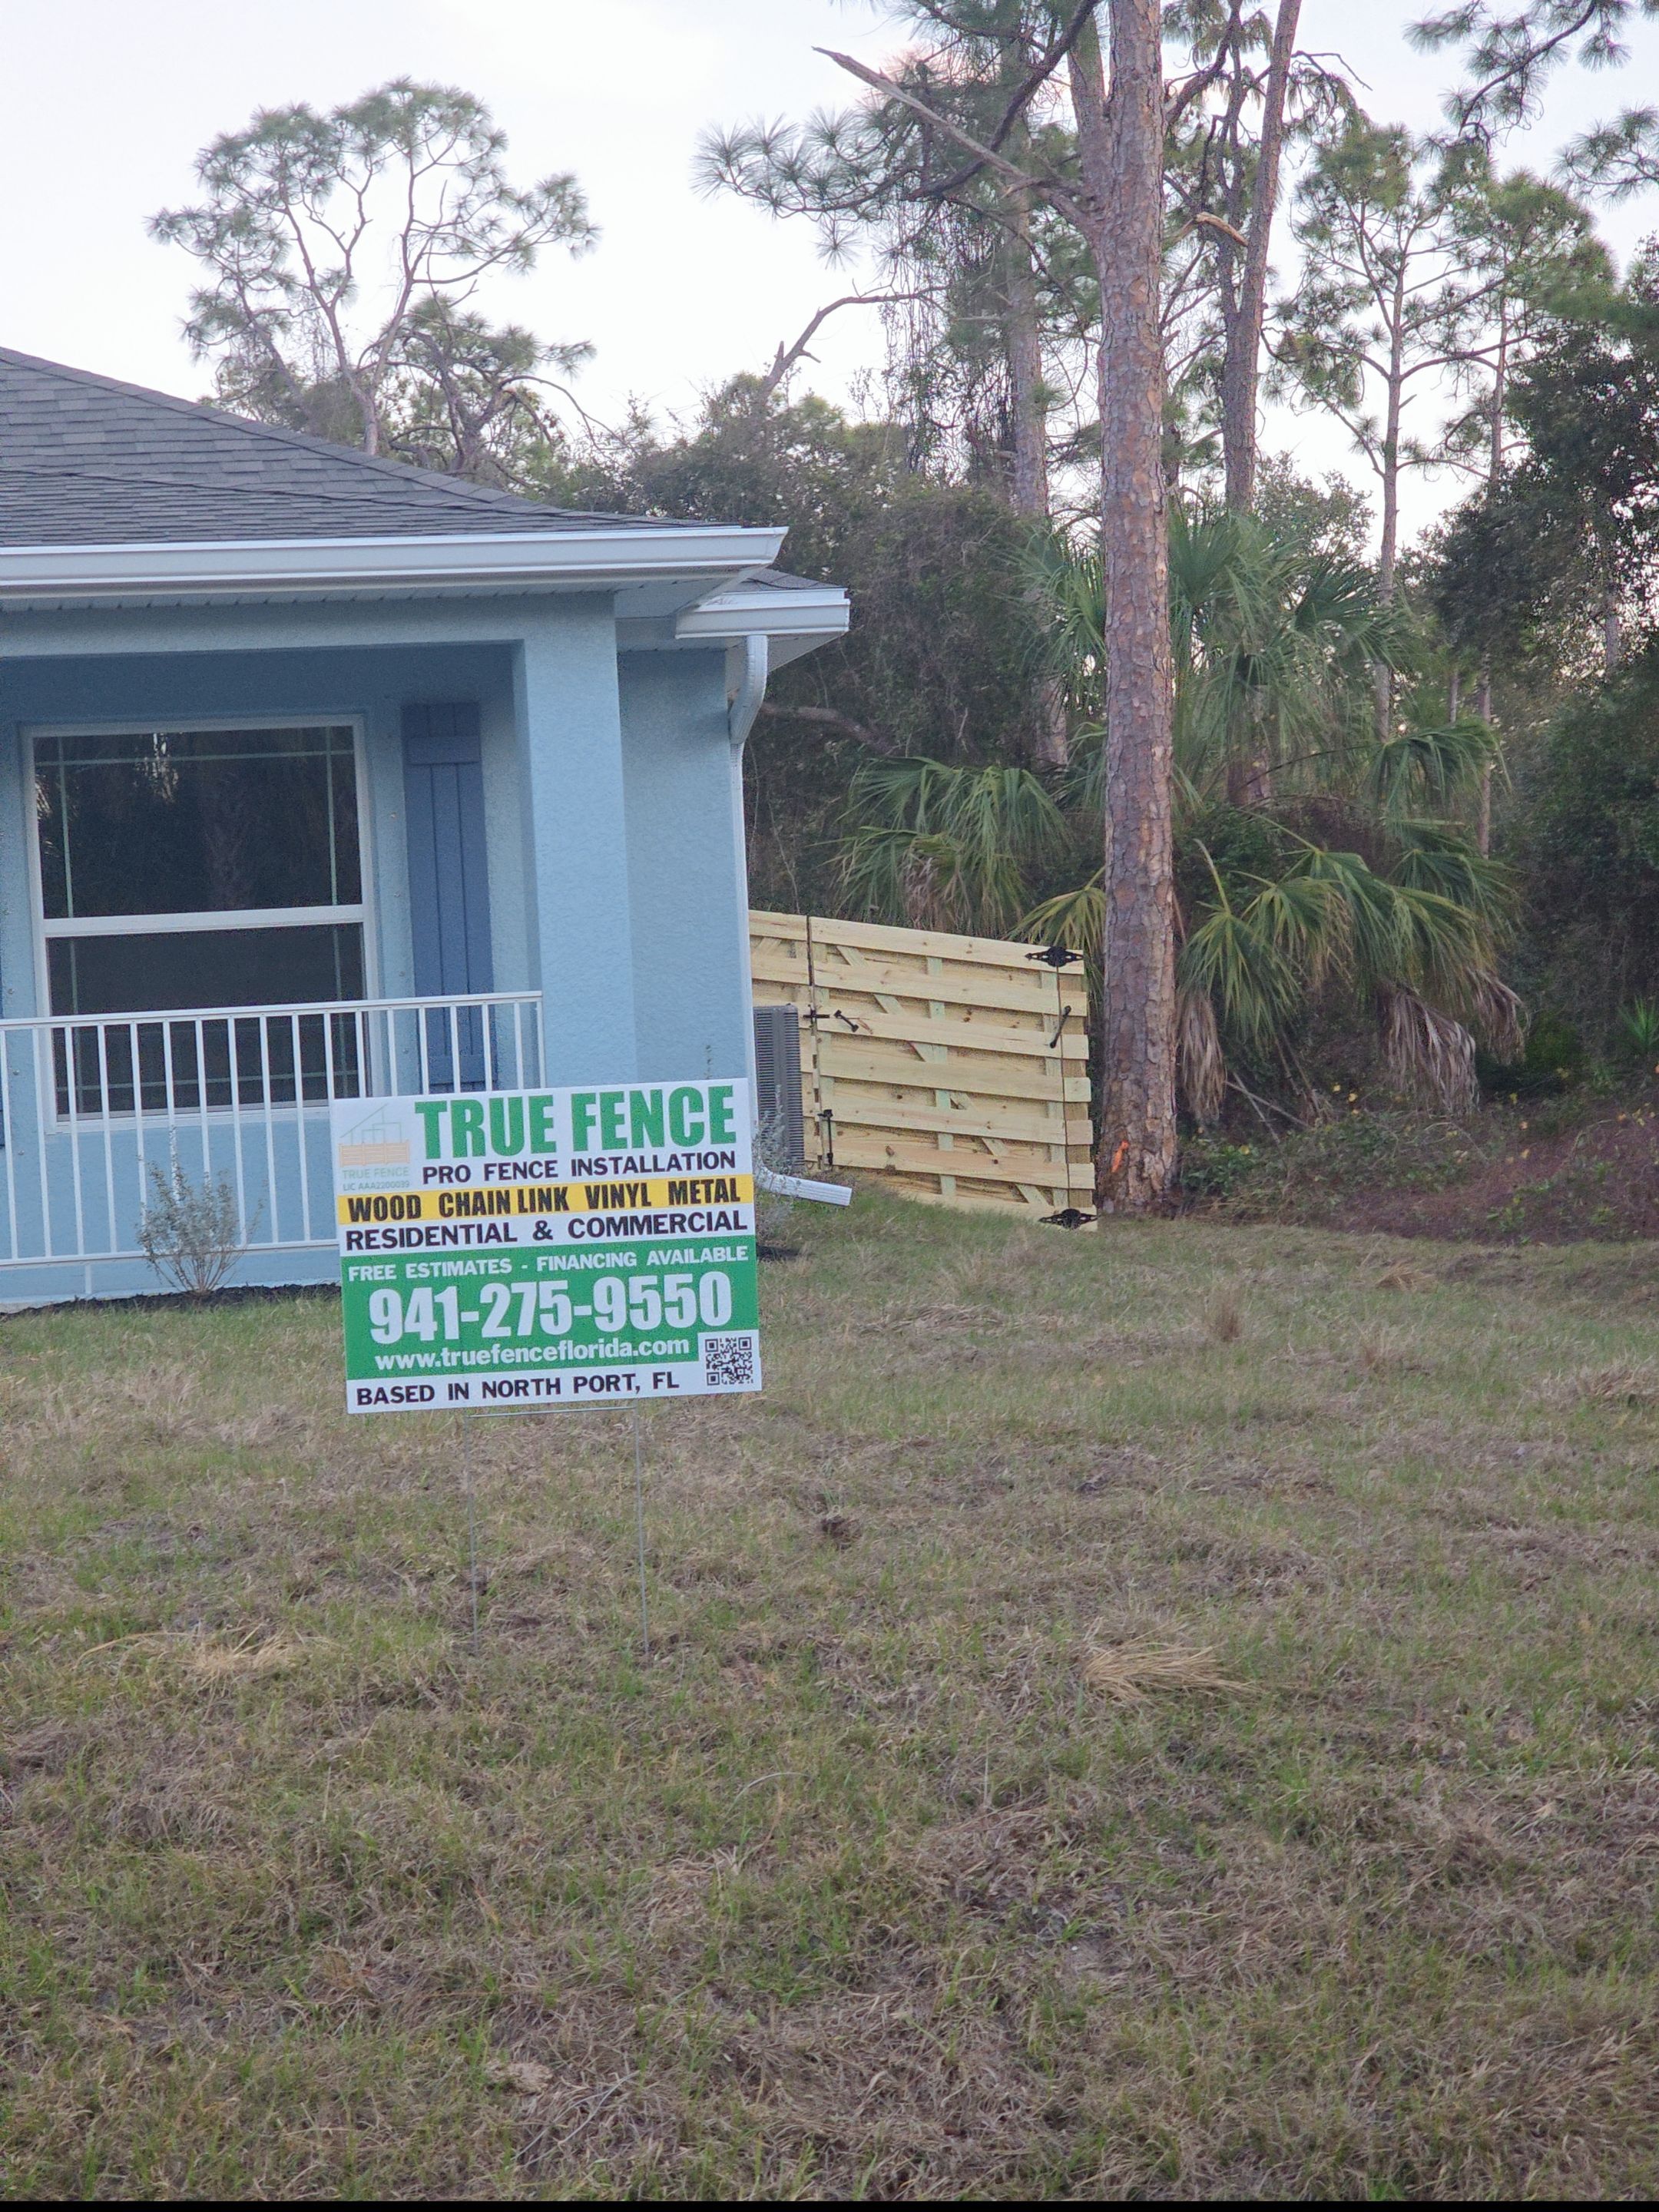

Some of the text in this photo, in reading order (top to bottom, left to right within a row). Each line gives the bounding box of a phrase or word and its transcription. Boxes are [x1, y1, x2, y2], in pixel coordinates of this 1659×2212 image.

[415, 1085, 737, 1159] TRUE FENCE
[342, 1167, 409, 1179] TRUE FENCE
[422, 1151, 736, 1184] PRO FENCE INSTALLATION
[343, 1183, 356, 1191] LIC
[347, 1178, 740, 1222] WOOD CHAIN LINK VINYL METAL
[346, 1210, 747, 1251] RESIDENTIAL & COMMERCIAL
[348, 1265, 396, 1281] FREE
[406, 1258, 512, 1278] ESTIMATES
[537, 1252, 637, 1272] FINANCING
[647, 1246, 749, 1266] AVAILABLE
[369, 1271, 732, 1344] 941-275-9550
[377, 1338, 689, 1370] www.truefenceflorida.com
[357, 1372, 679, 1406] BASED IN NORTH PORT, FL
